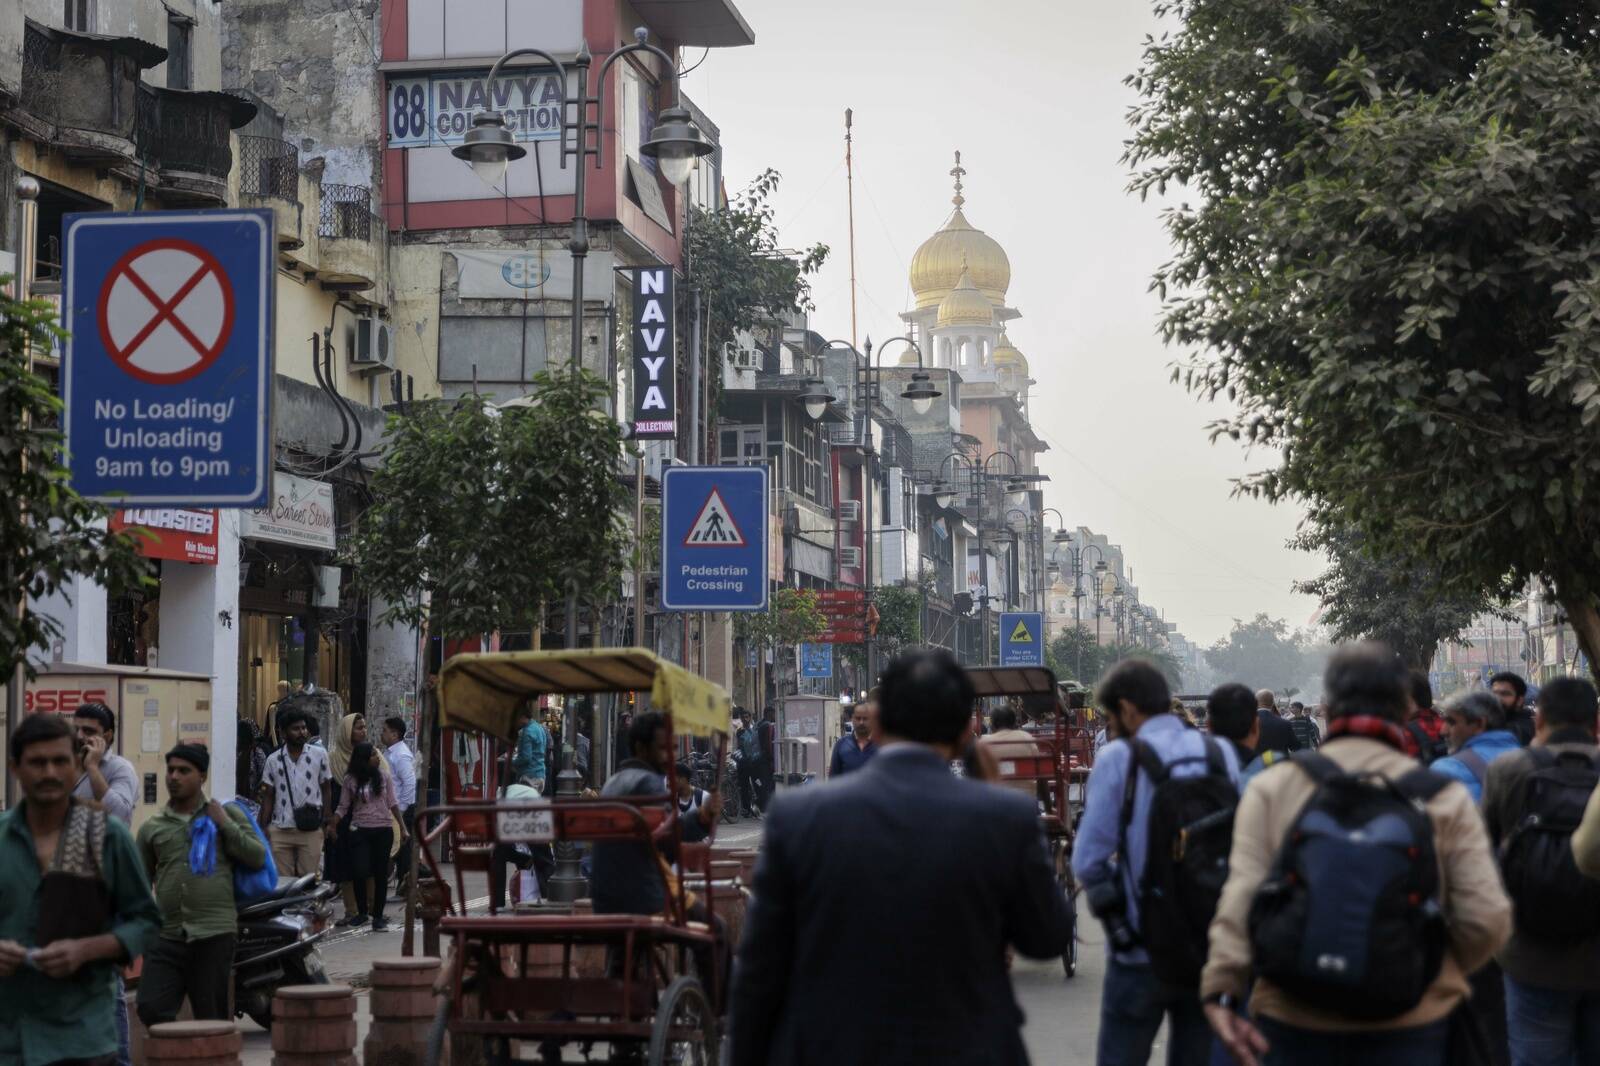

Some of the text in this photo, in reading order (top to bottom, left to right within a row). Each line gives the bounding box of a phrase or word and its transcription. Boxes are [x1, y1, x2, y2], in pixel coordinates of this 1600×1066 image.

[438, 77, 562, 110] NAVYA
[394, 84, 425, 139] 88
[437, 107, 562, 136] COLCTION
[640, 270, 667, 410] NAVYA
[94, 397, 234, 423] No Loading/
[105, 427, 222, 452] Unloading
[95, 456, 230, 481] 9am to 9pm
[681, 565, 748, 576] Pedestrian
[686, 579, 743, 592] Crossing
